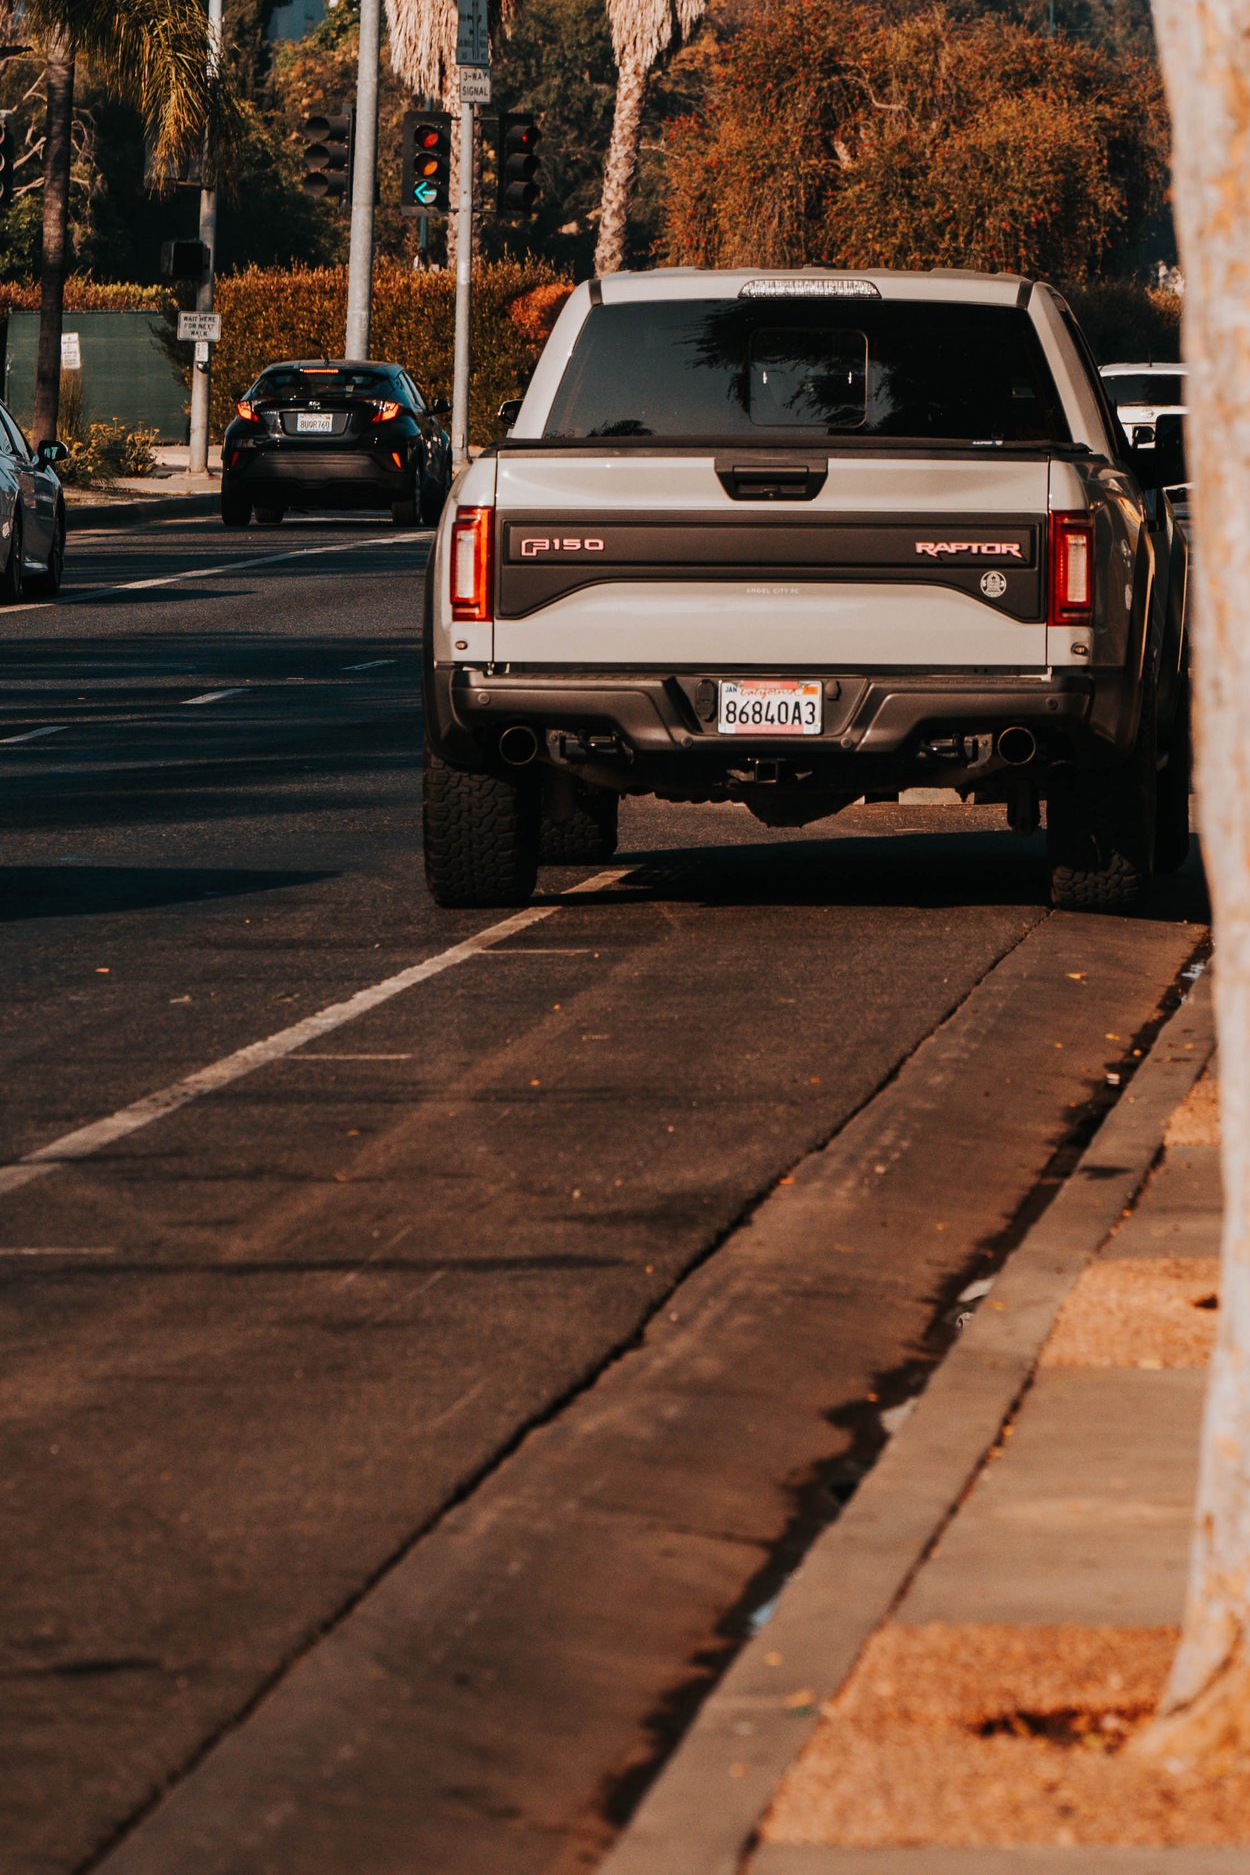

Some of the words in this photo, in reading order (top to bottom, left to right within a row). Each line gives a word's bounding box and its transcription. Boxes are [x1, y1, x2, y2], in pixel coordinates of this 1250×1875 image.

[463, 71, 488, 82] 3-WAY
[462, 86, 489, 96] SIGNAL
[915, 542, 1023, 559] RAPTOR
[725, 700, 816, 725] 86840A3
